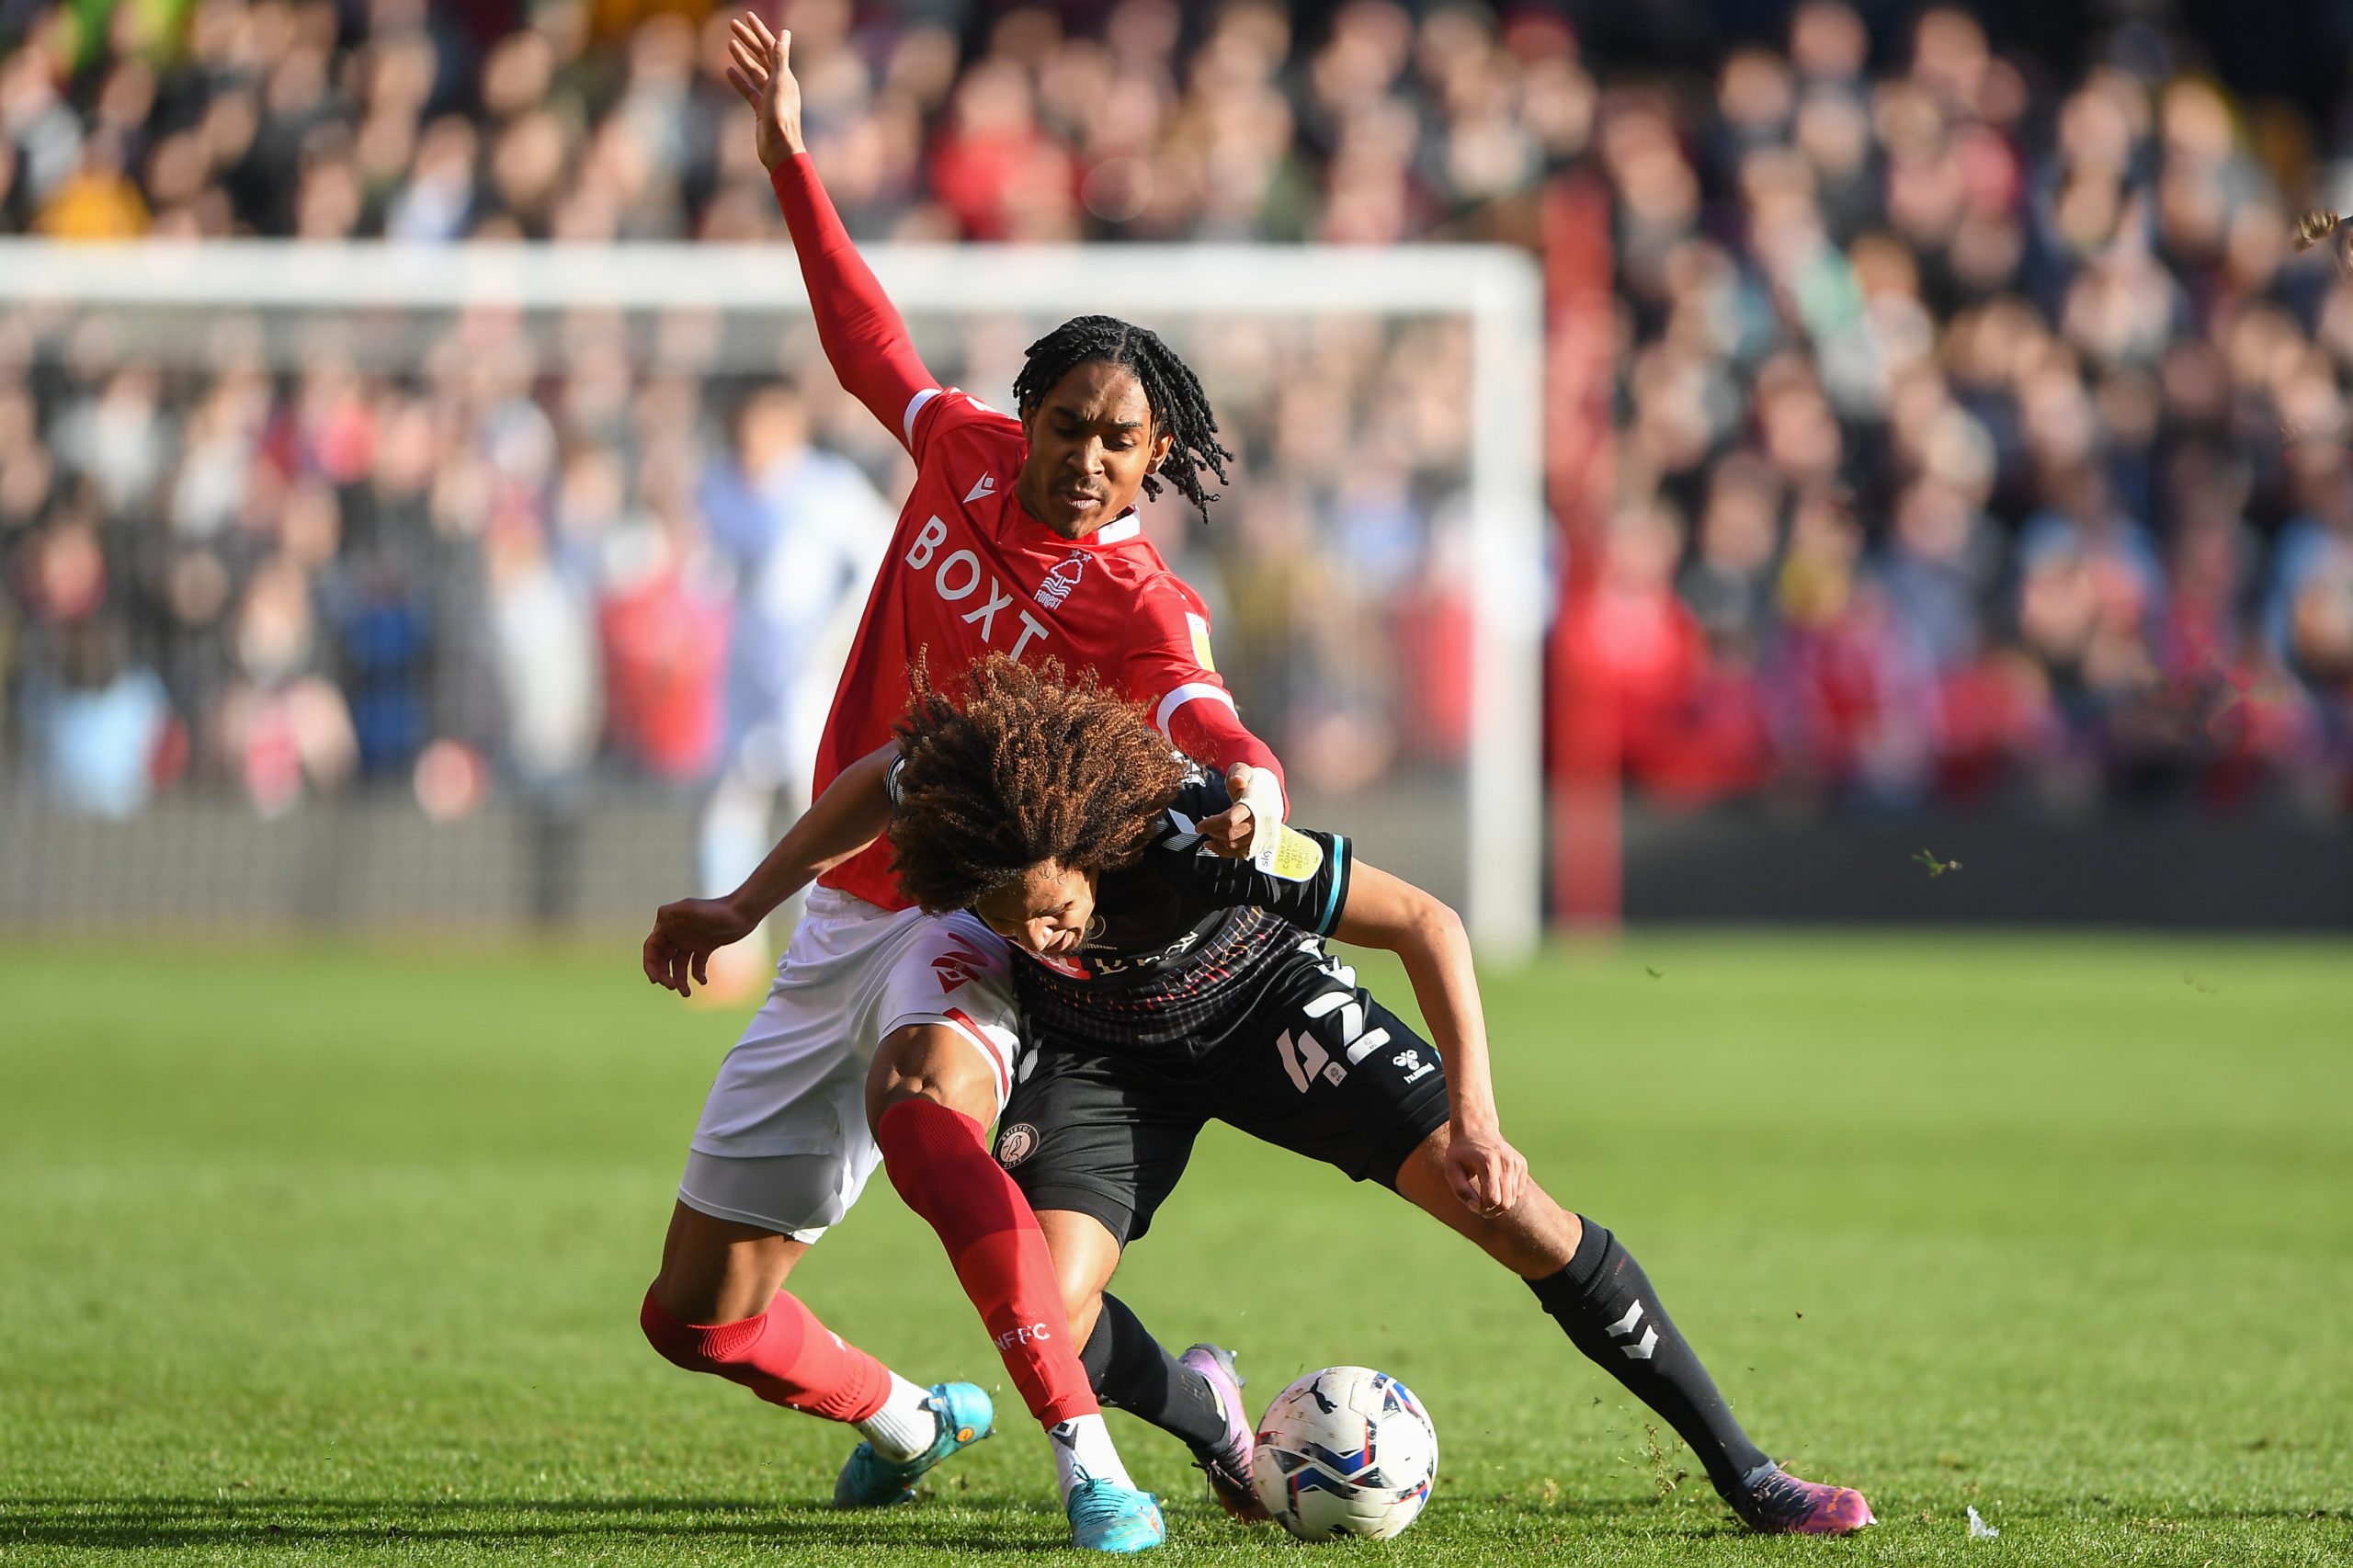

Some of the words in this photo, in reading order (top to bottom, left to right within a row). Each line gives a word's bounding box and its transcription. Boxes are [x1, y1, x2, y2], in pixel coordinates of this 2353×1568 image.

[904, 515, 1050, 662] BOXT
[1282, 835, 1294, 869] CONTRO
[1276, 991, 1391, 1094] 42
[1002, 1126, 1031, 1142] BRISTOL
[1004, 1157, 1022, 1168] CITY
[994, 1323, 1051, 1351] NFFC
